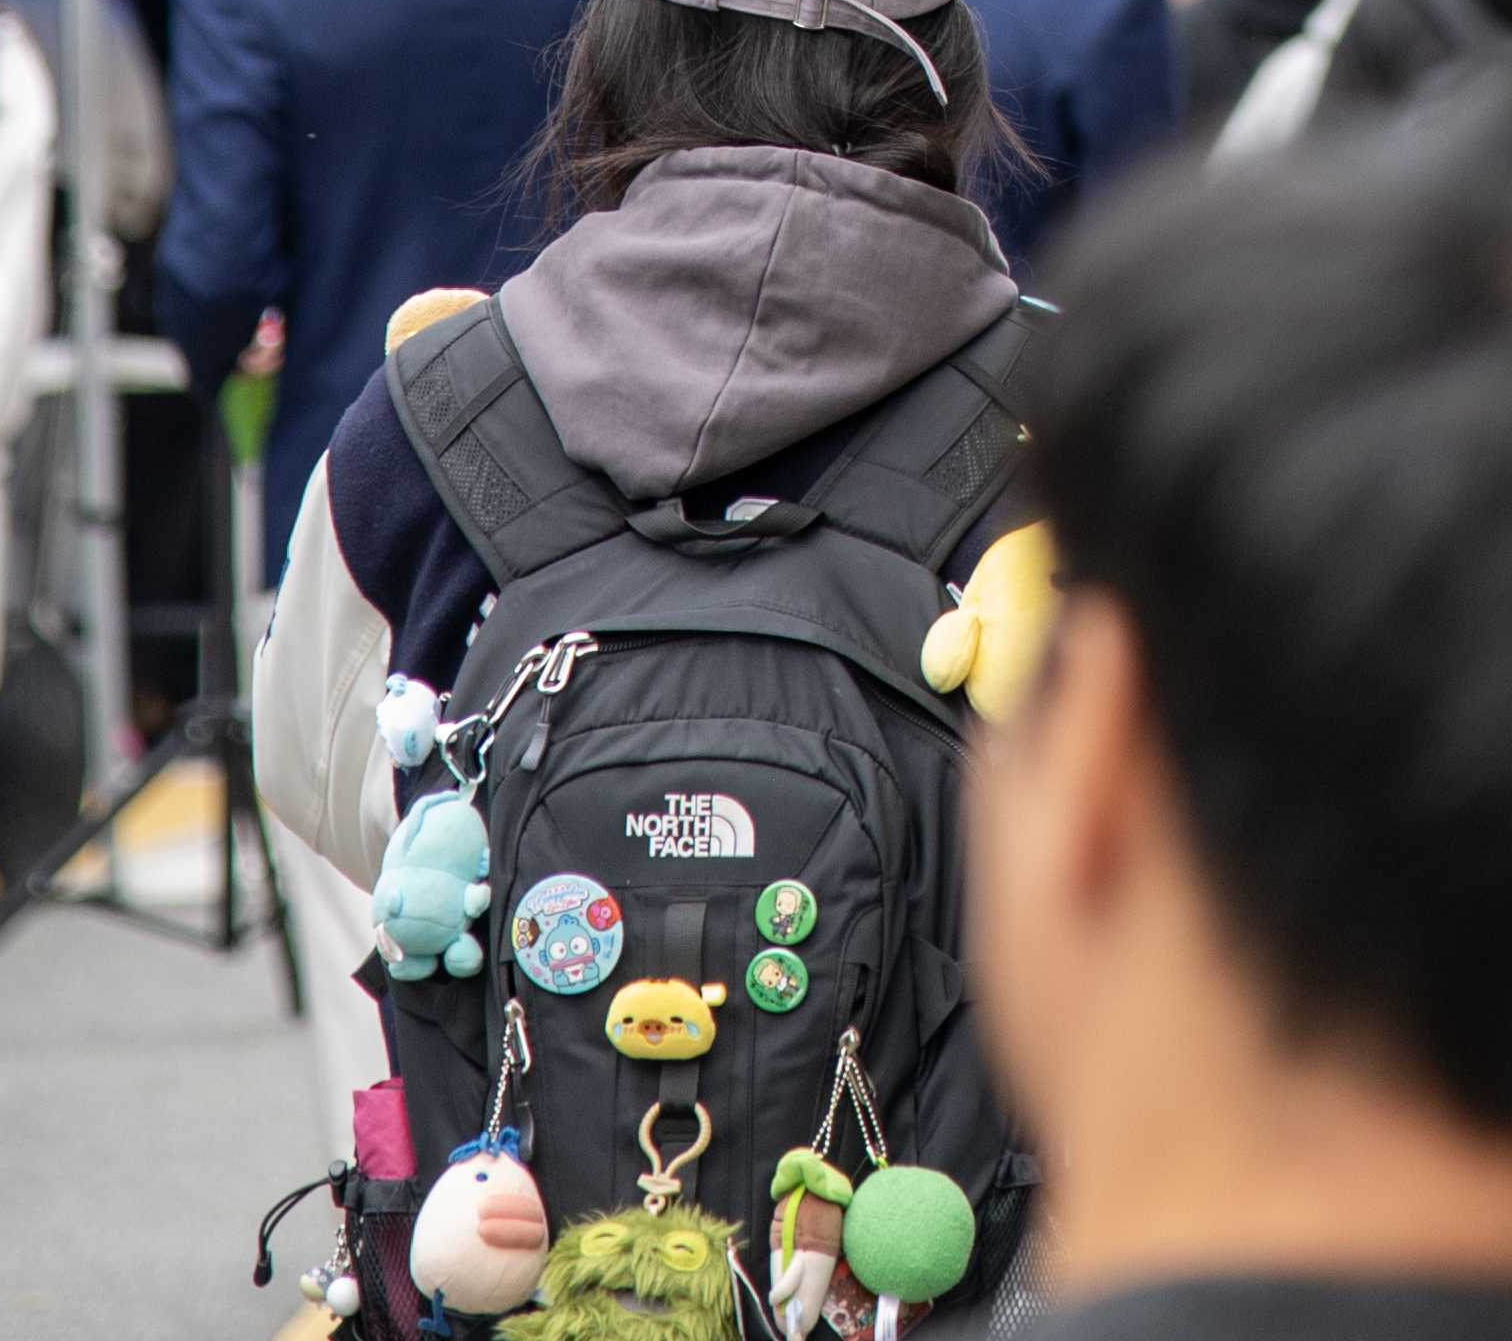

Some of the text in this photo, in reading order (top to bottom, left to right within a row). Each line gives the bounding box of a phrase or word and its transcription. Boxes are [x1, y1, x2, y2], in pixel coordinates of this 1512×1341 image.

[664, 793, 711, 816] THE
[625, 813, 710, 837] NORTH
[648, 835, 710, 858] FACE
